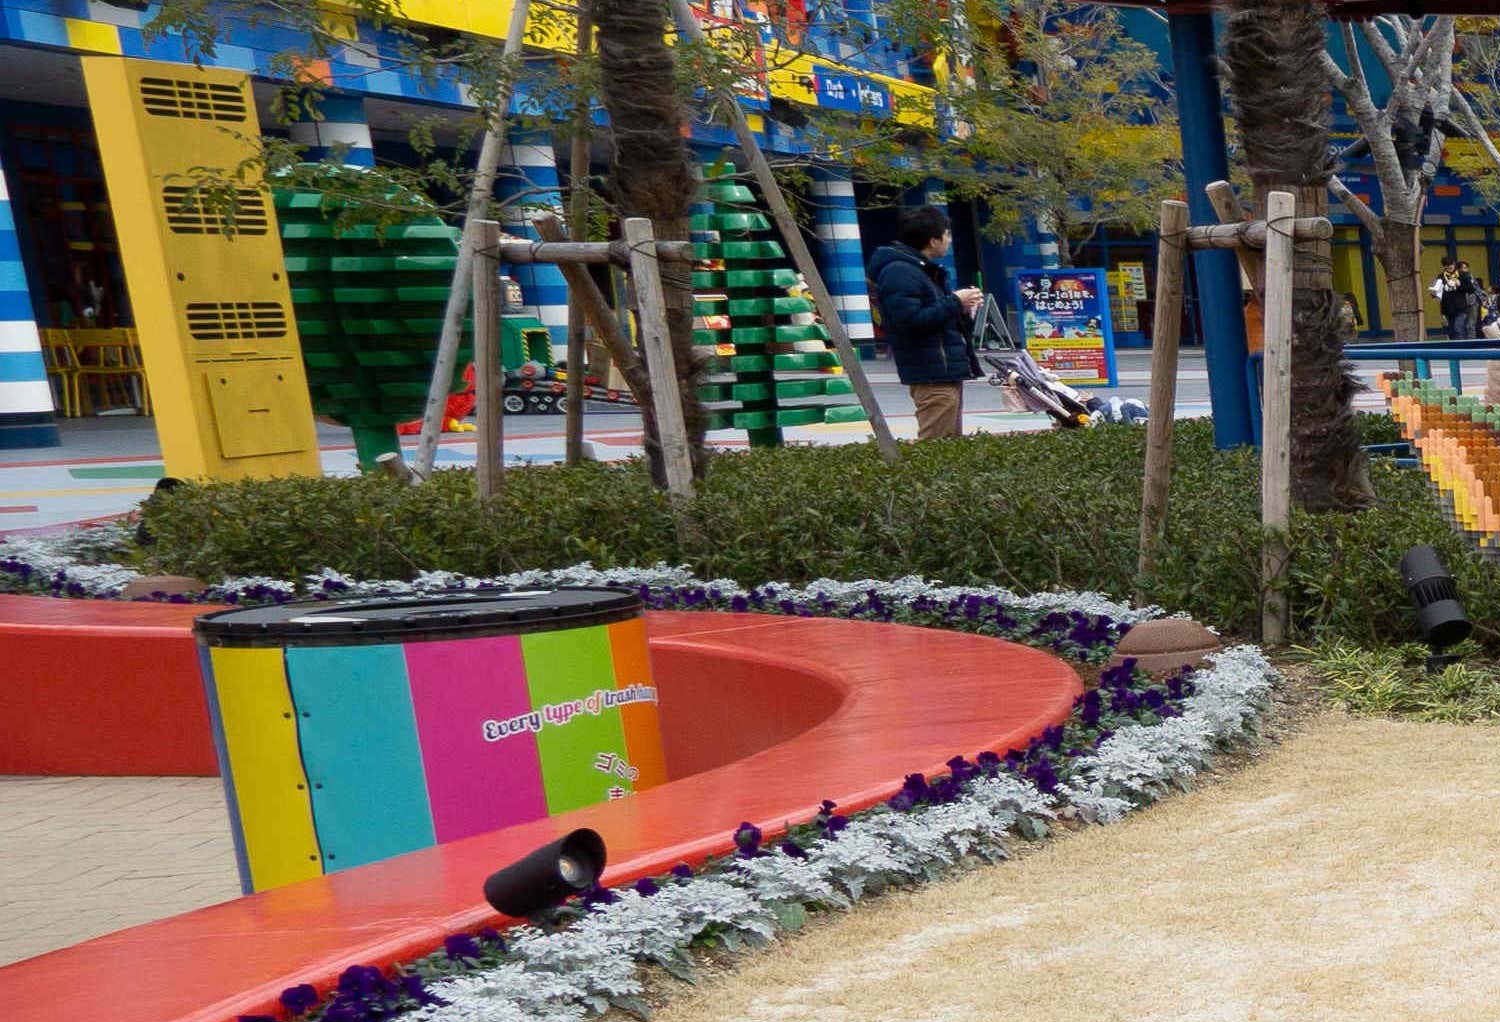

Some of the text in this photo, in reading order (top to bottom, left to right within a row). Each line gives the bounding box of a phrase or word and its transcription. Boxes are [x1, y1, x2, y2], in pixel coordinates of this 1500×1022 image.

[485, 713, 541, 740] Every
[545, 701, 582, 723] type
[587, 691, 601, 714] of
[605, 686, 636, 705] trash
